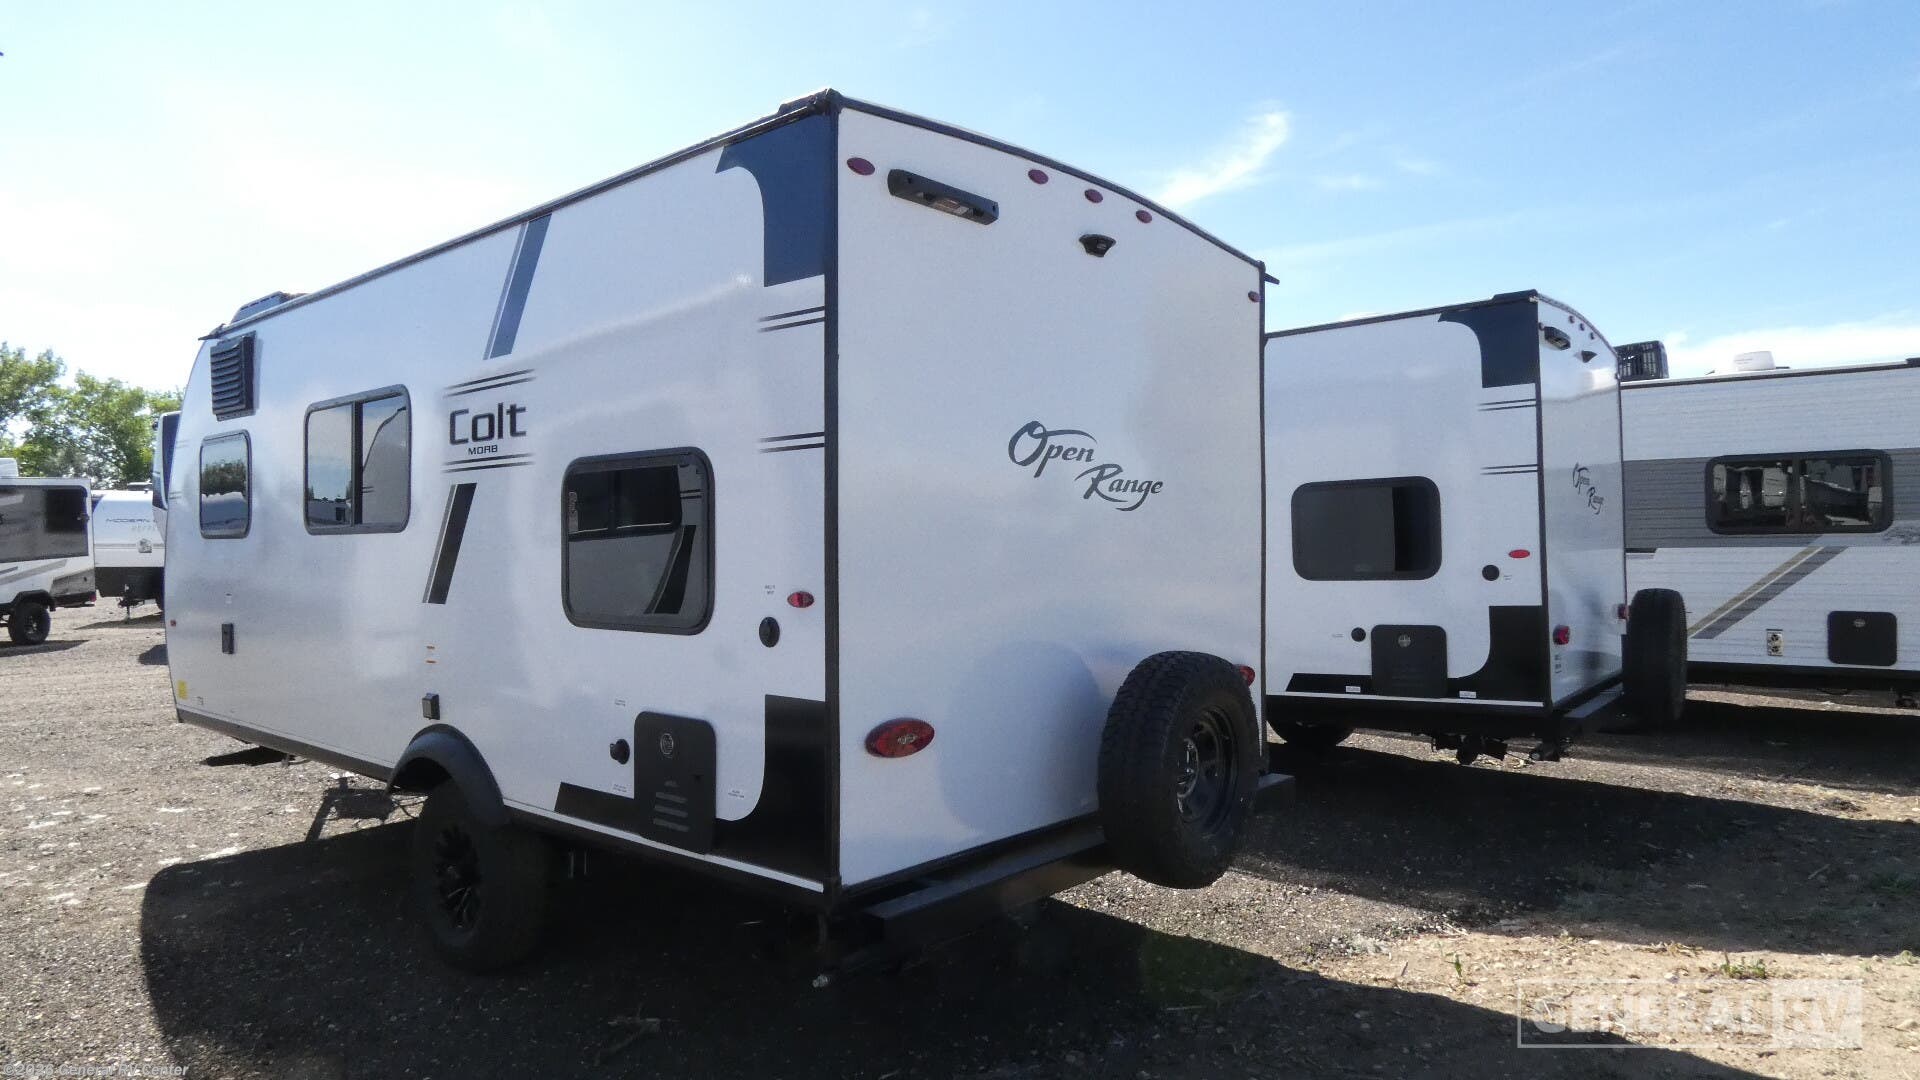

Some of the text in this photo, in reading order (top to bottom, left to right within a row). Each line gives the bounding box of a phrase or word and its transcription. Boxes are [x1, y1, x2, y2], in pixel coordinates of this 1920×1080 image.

[449, 402, 527, 445] Colt
[1008, 420, 1098, 478] Open
[1074, 463, 1164, 512] Range
